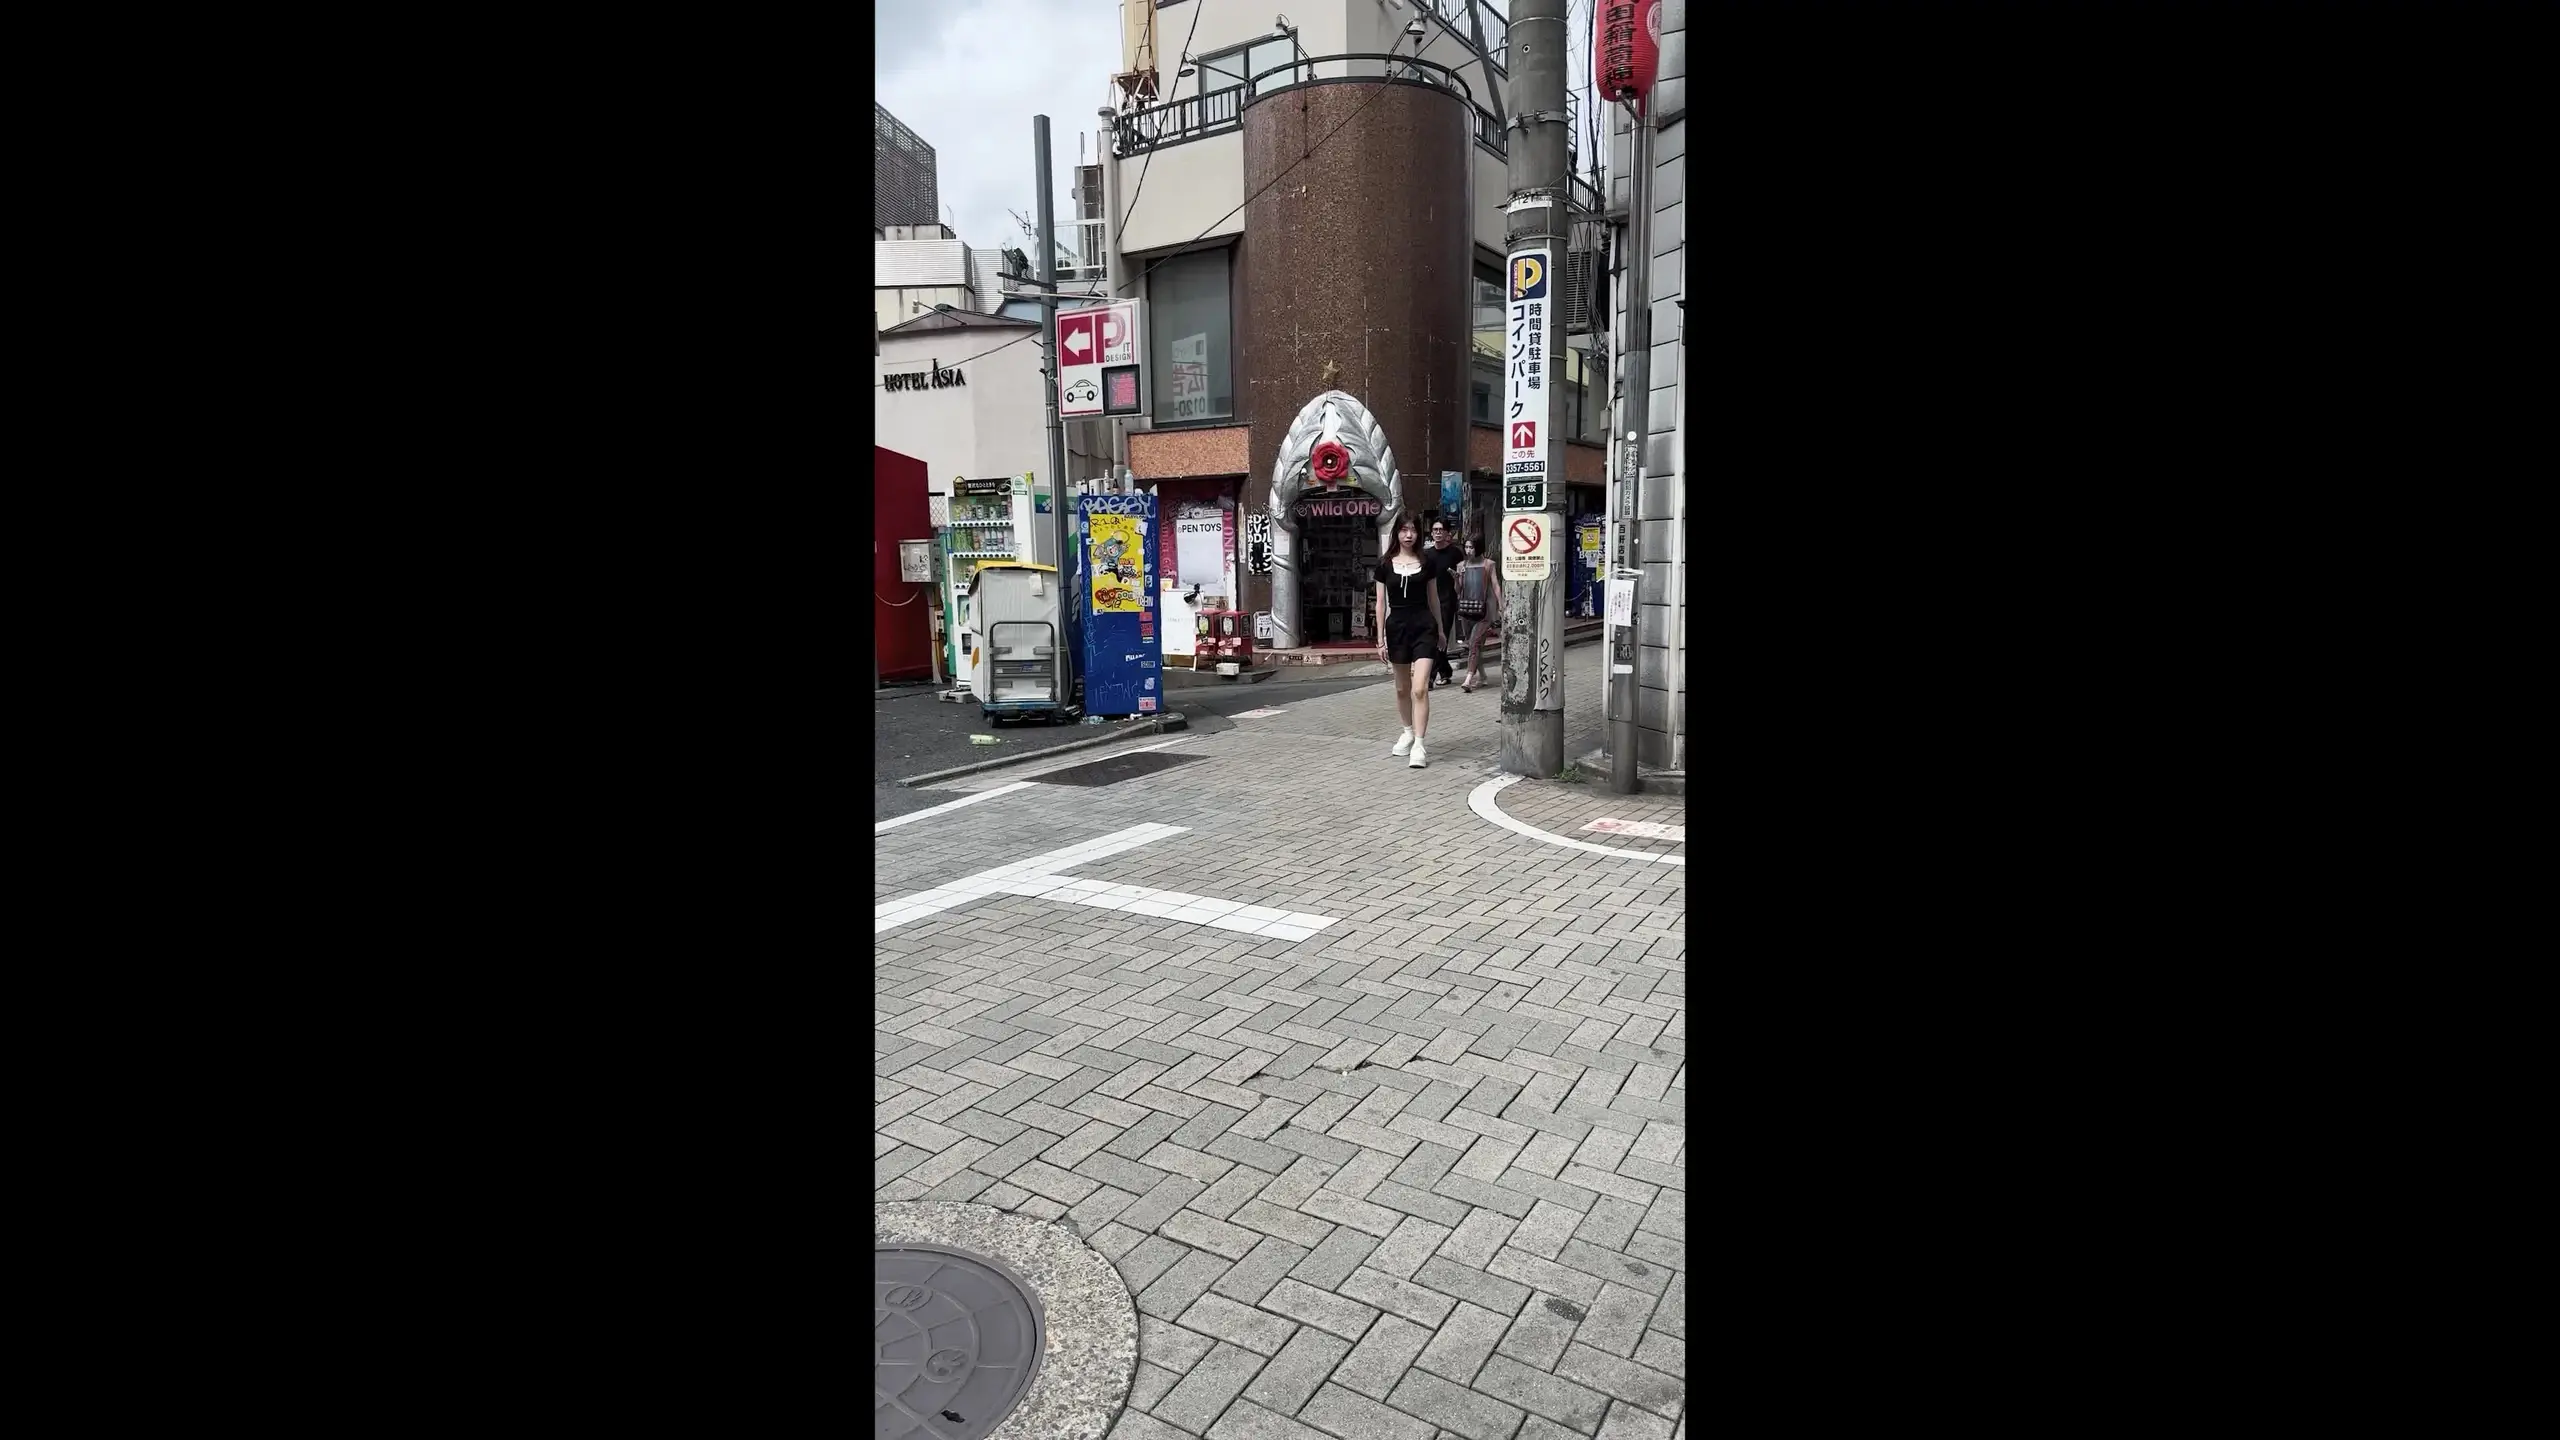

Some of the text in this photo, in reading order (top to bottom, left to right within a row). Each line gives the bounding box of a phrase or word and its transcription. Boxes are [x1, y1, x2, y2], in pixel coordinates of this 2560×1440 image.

[1603, 0, 1634, 92] 田稲荷神
[1527, 302, 1543, 390] 時間貸駐車場
[1105, 352, 1132, 363] DESIGN
[1510, 304, 1526, 420] コインパーク
[883, 358, 967, 392] HOTEL ASIA
[1511, 449, 1536, 459] この先
[1506, 462, 1544, 473] 3357-5561
[1509, 483, 1537, 494] 道玄坂
[1510, 494, 1536, 505] 2-19
[1199, 522, 1222, 533] TOYS
[1253, 514, 1262, 543] DVD
